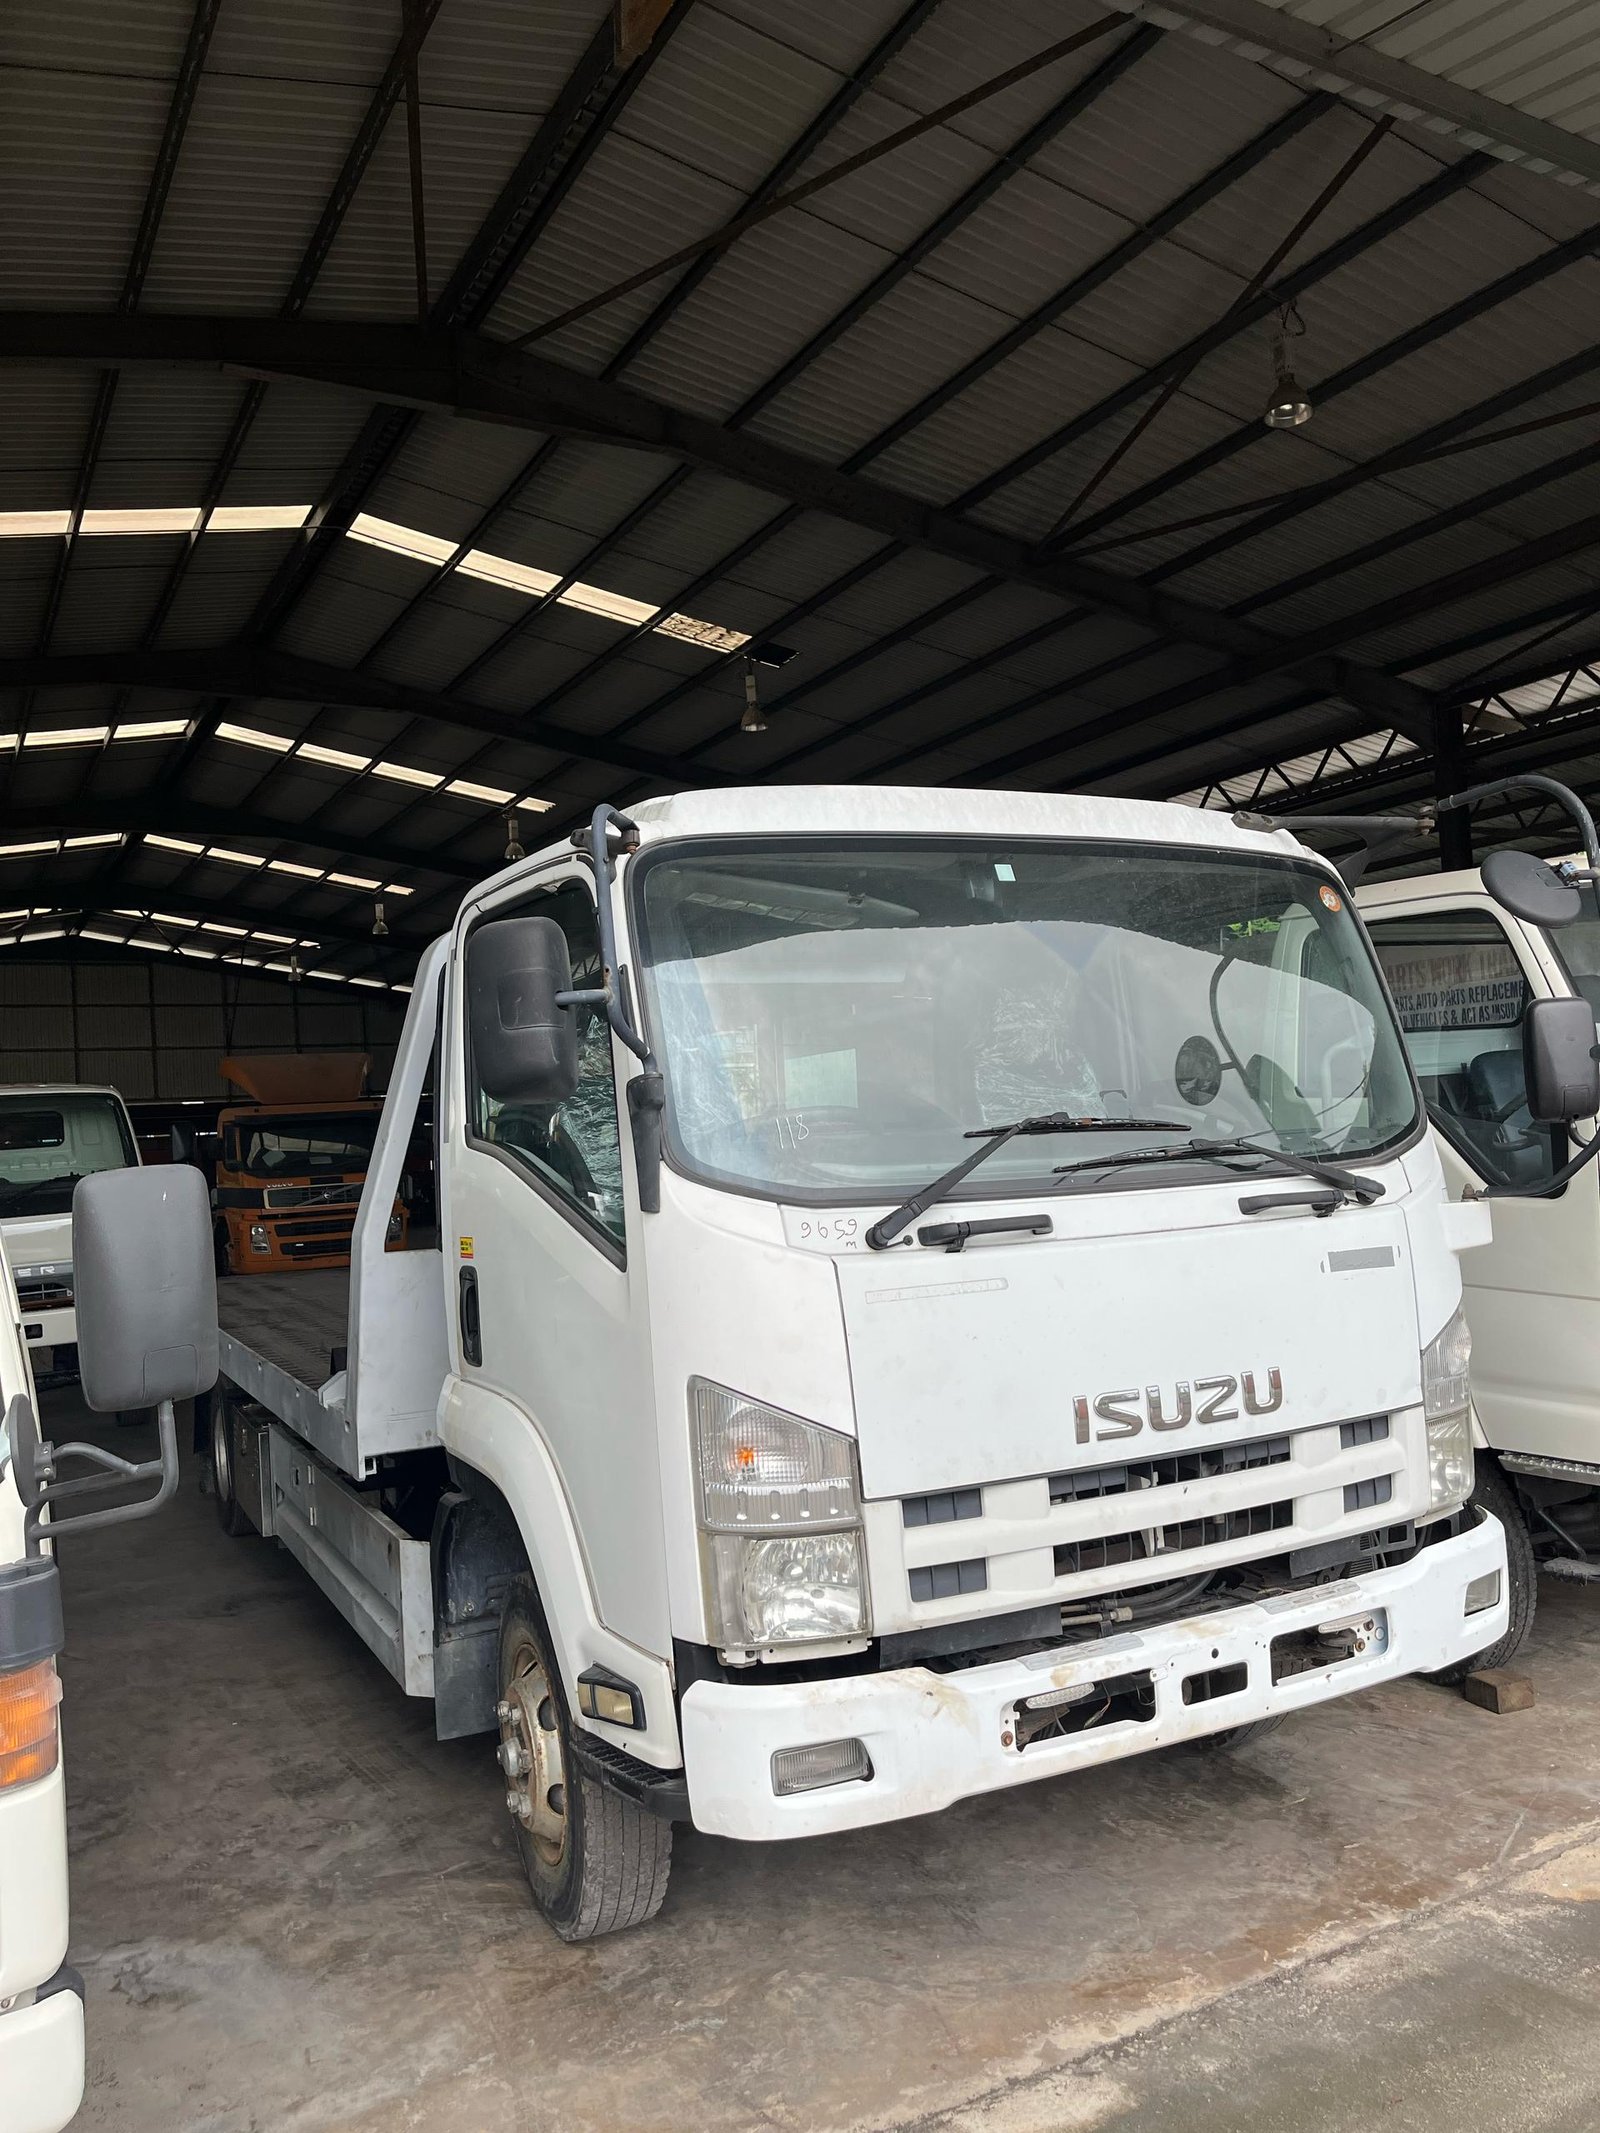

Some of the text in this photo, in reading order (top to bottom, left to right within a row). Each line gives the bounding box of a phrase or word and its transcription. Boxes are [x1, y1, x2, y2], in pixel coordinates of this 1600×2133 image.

[1416, 992, 1438, 1010] AUTO
[1440, 988, 1466, 1007] PARTS
[1451, 1009, 1459, 1025] &
[1461, 1005, 1478, 1024] ACT
[1479, 1005, 1490, 1023] AS
[776, 1114, 809, 1149] 118
[1072, 1366, 1284, 1444] ISUZU
